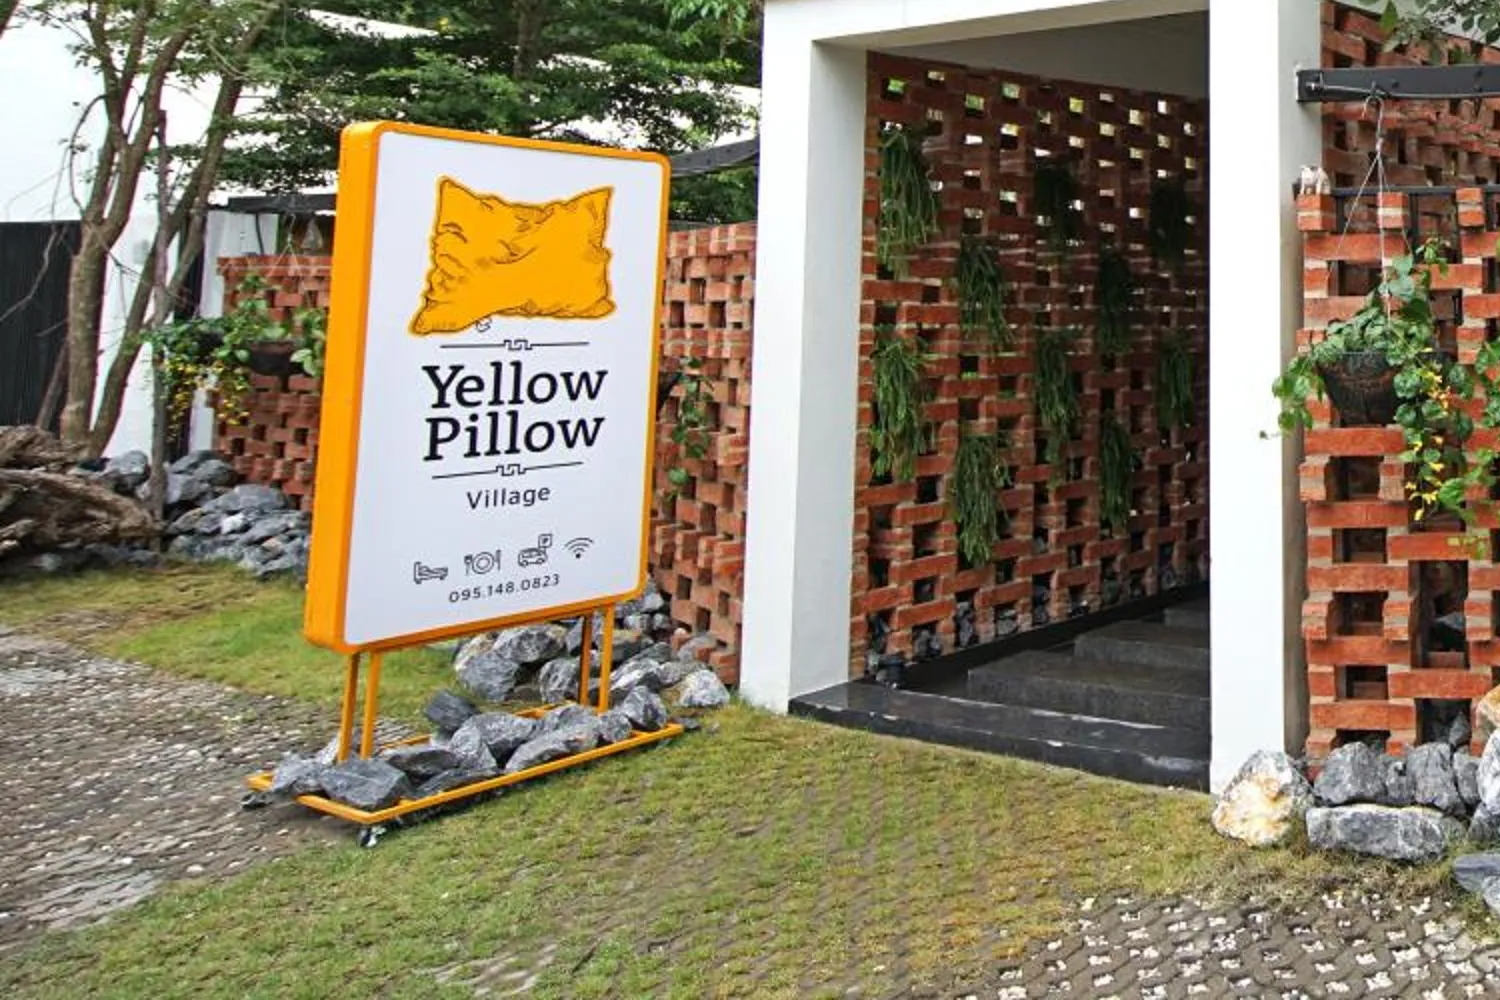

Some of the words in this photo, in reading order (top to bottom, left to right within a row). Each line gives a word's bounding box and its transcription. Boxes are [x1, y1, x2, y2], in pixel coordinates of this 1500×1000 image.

[420, 359, 609, 410] Yellow
[422, 409, 606, 463] Pillow
[466, 486, 551, 510] Village
[448, 573, 560, 604] 095.148.0823
